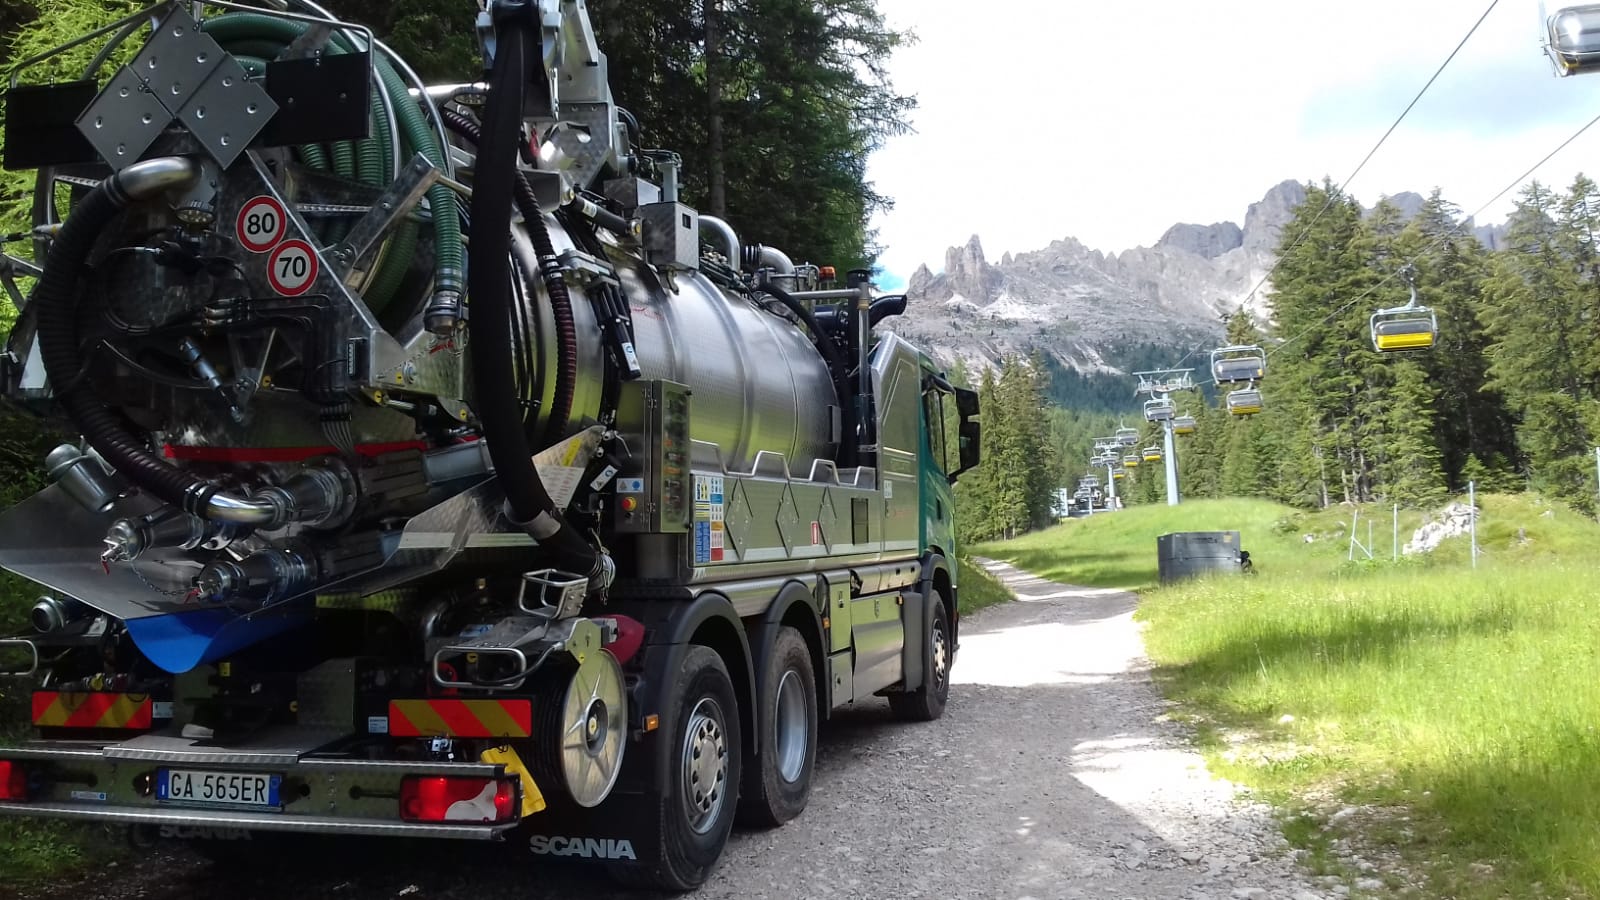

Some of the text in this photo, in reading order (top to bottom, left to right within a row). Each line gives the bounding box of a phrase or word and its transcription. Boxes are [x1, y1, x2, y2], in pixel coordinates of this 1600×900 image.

[247, 212, 275, 235] 80
[279, 255, 306, 278] 70
[171, 773, 266, 802] GA 565ER
[529, 834, 637, 860] SCANIA
